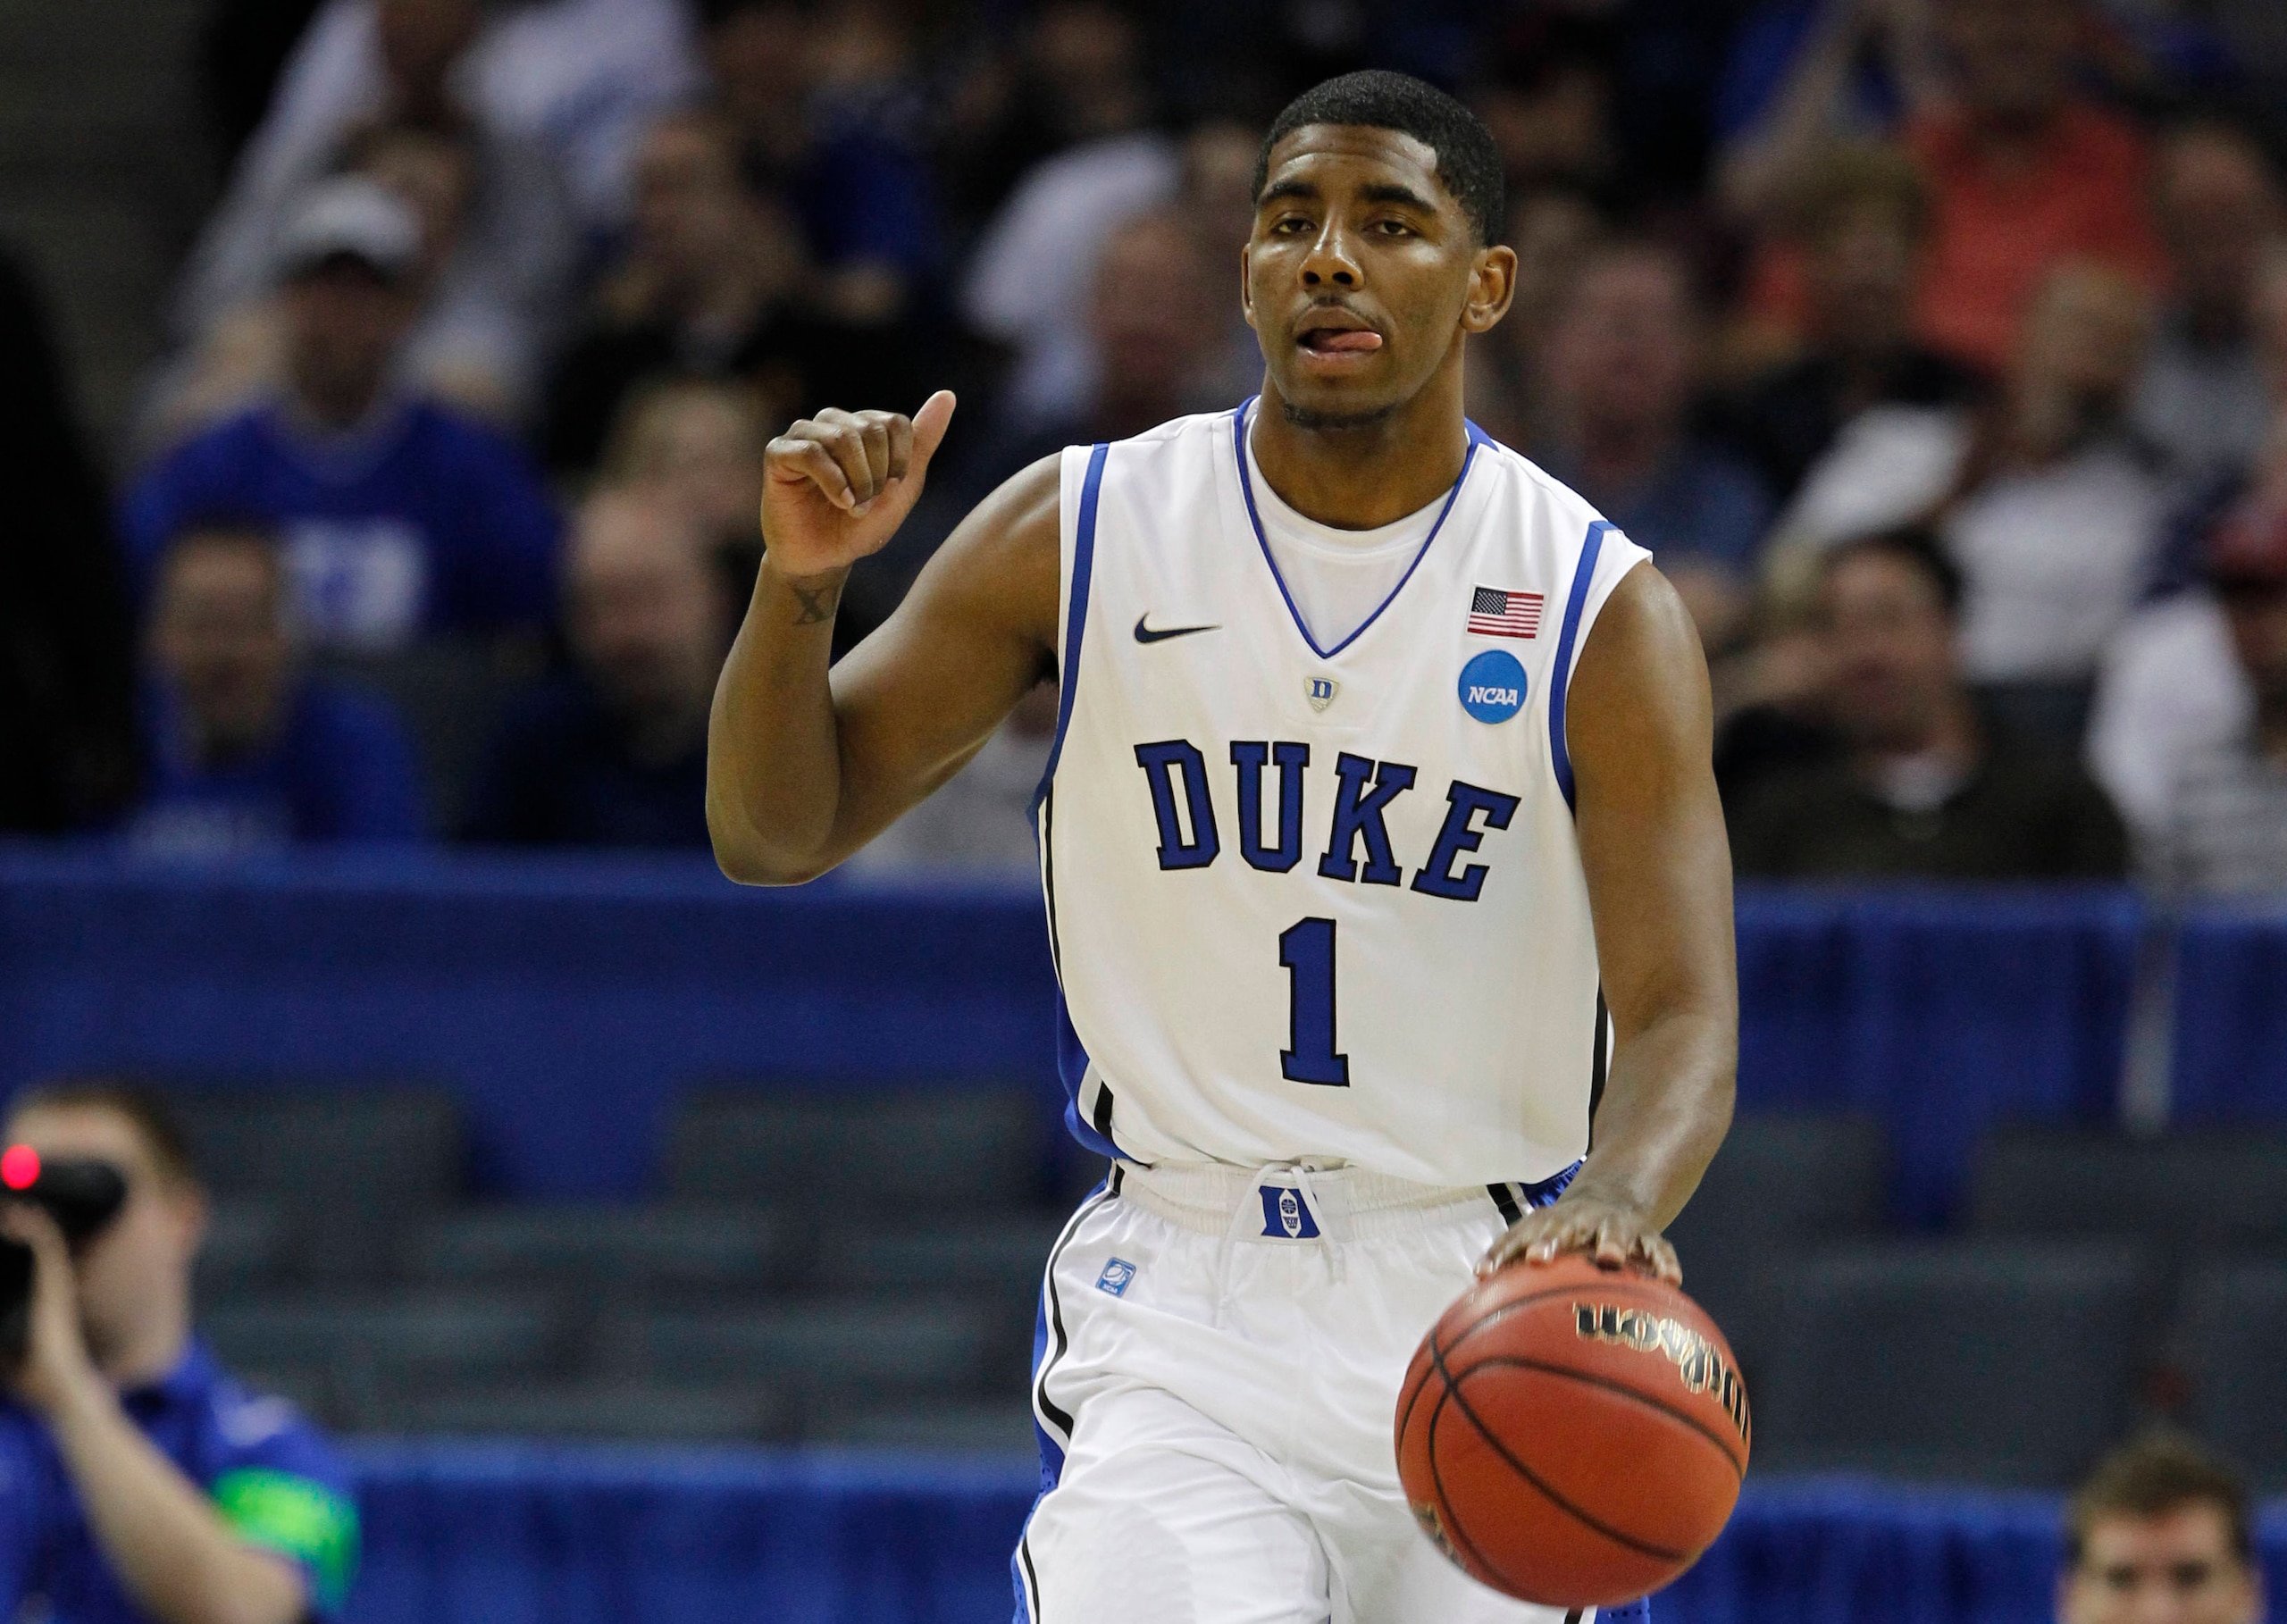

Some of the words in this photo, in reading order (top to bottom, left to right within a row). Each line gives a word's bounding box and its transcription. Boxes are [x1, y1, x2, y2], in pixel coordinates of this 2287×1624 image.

[1468, 686, 1519, 707] NCAA
[1134, 739, 1521, 902] DUKE
[1279, 917, 1350, 1087] 1
